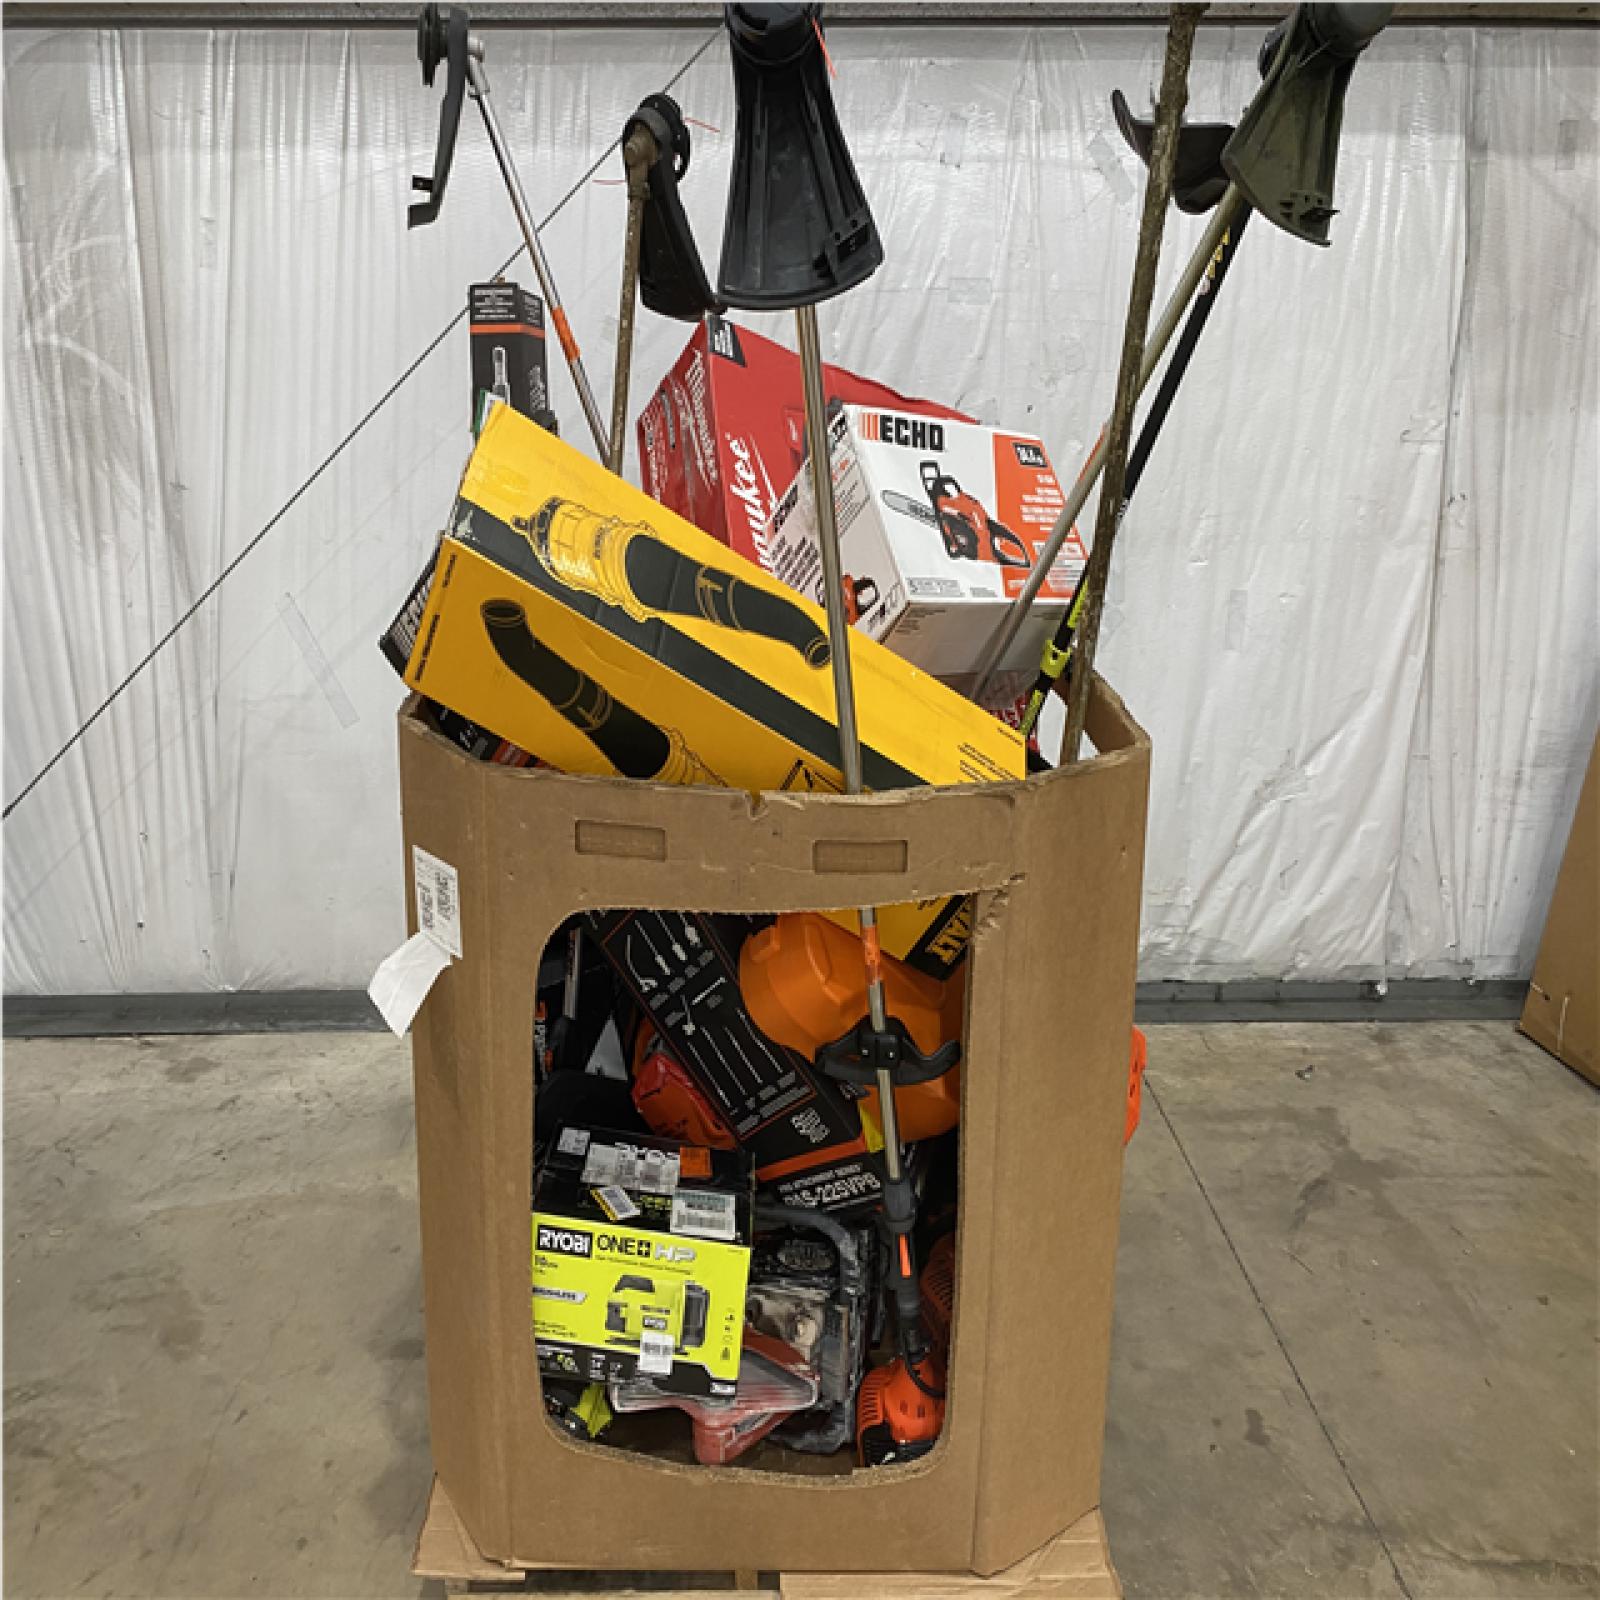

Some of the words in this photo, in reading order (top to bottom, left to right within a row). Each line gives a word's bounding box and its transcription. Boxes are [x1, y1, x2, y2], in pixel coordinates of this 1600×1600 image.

[880, 415, 944, 451] ECHO
[539, 1228, 590, 1254] RYOBI
[654, 1243, 696, 1262] HP
